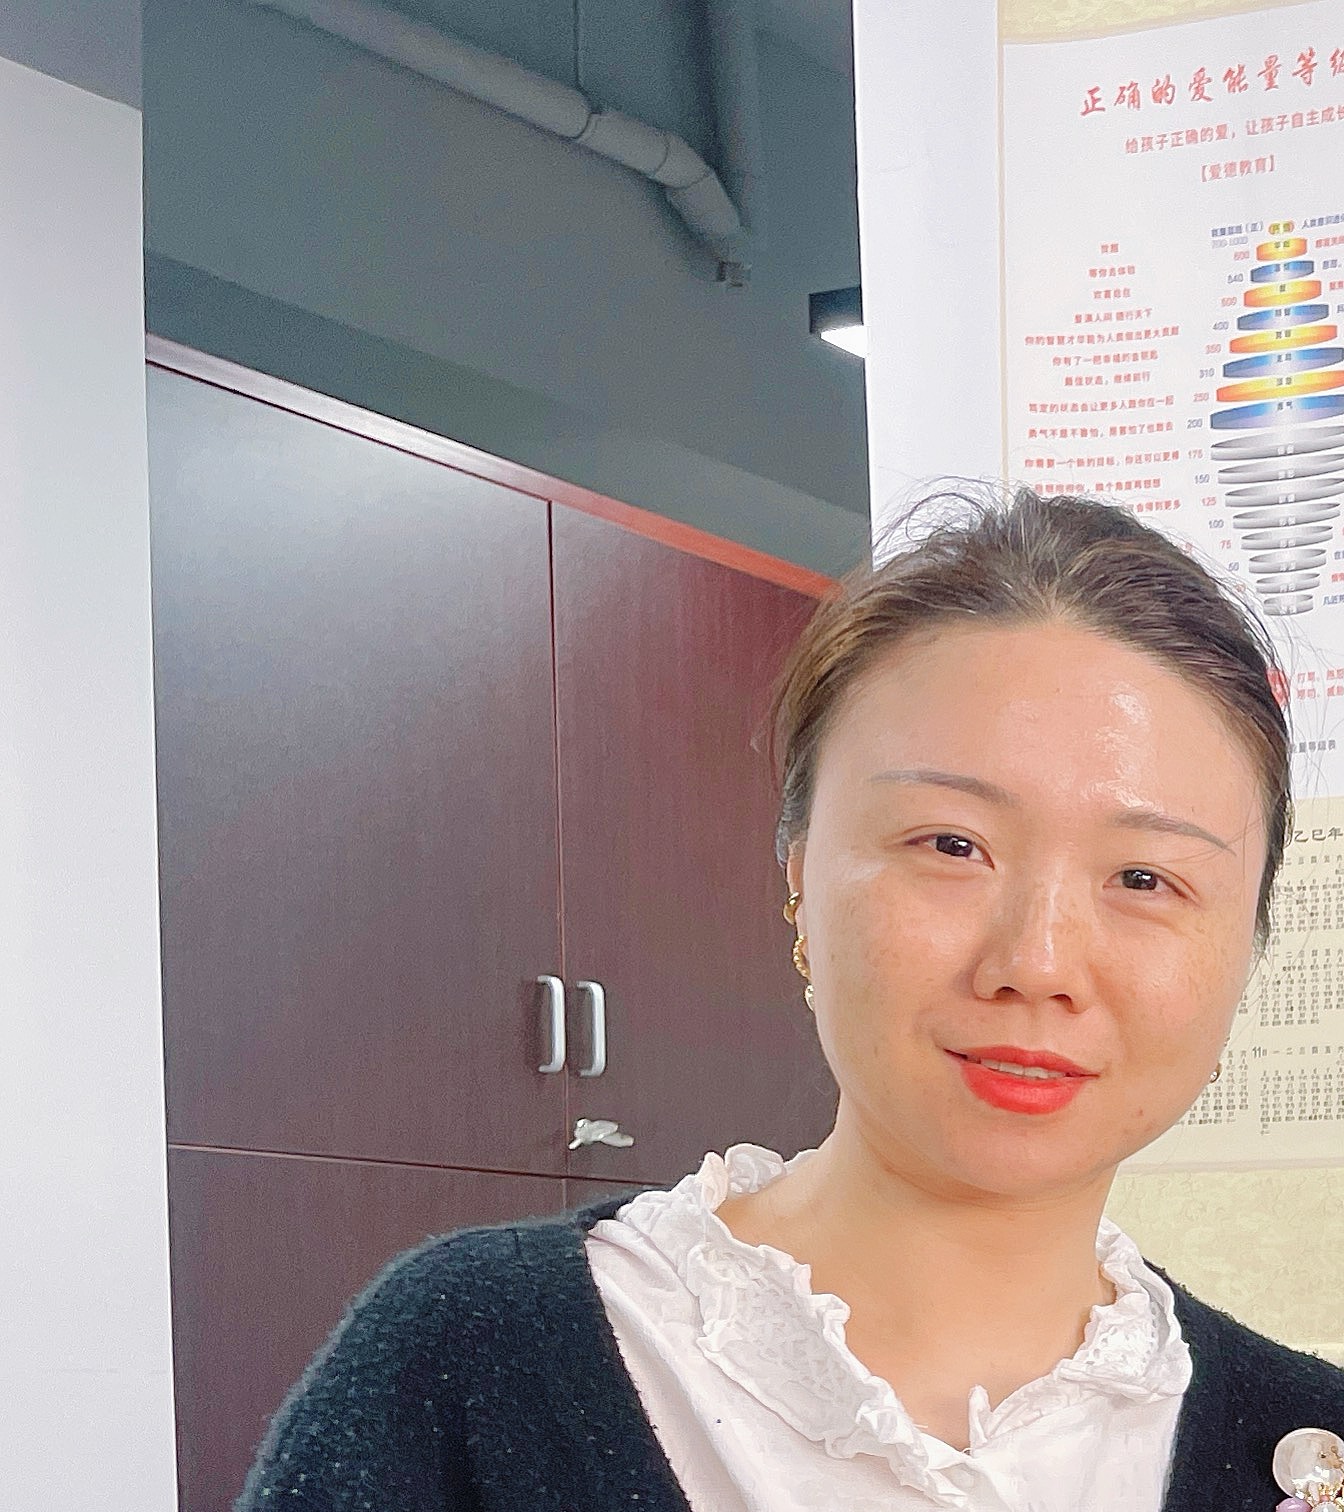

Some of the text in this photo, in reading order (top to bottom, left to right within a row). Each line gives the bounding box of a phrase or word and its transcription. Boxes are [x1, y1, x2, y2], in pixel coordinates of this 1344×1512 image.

[1194, 474, 1210, 484] 150
[1208, 520, 1224, 529] 100
[1294, 827, 1343, 842] 乙巳年
